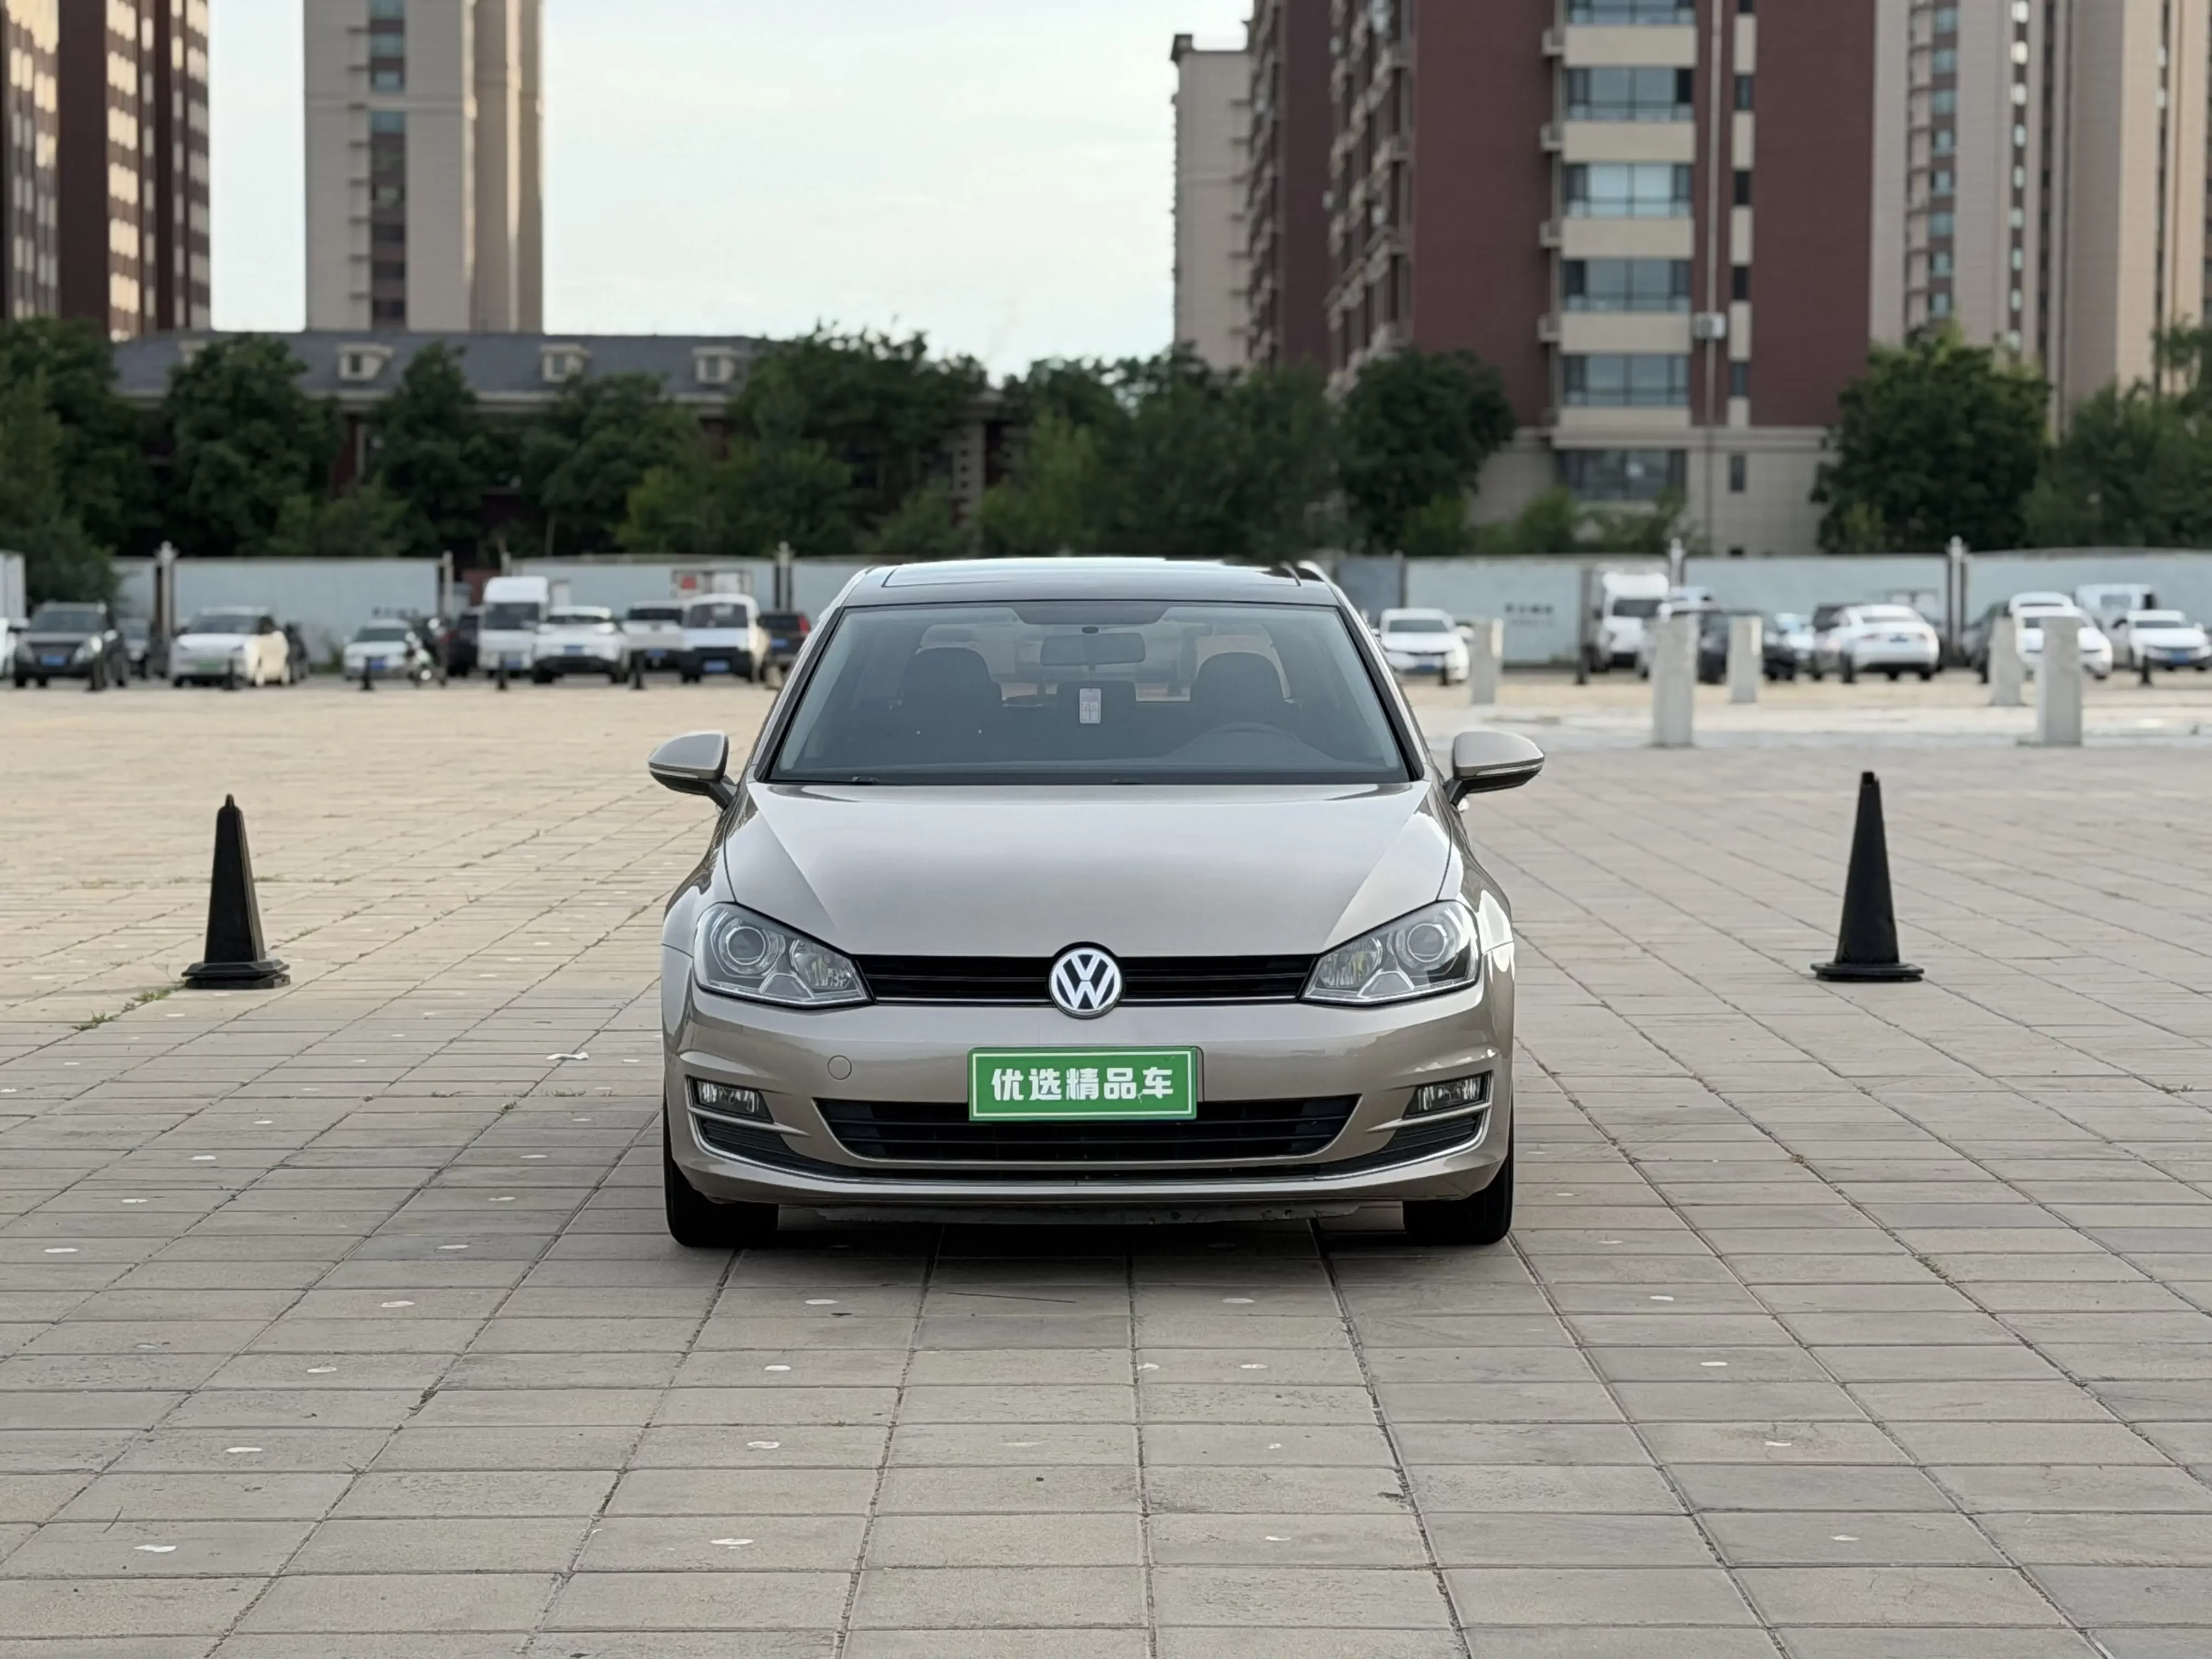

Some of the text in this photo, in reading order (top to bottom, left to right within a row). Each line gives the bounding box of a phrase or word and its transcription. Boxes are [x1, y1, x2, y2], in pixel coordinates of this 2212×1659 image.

[991, 1066, 1173, 1102] 优选精品车
